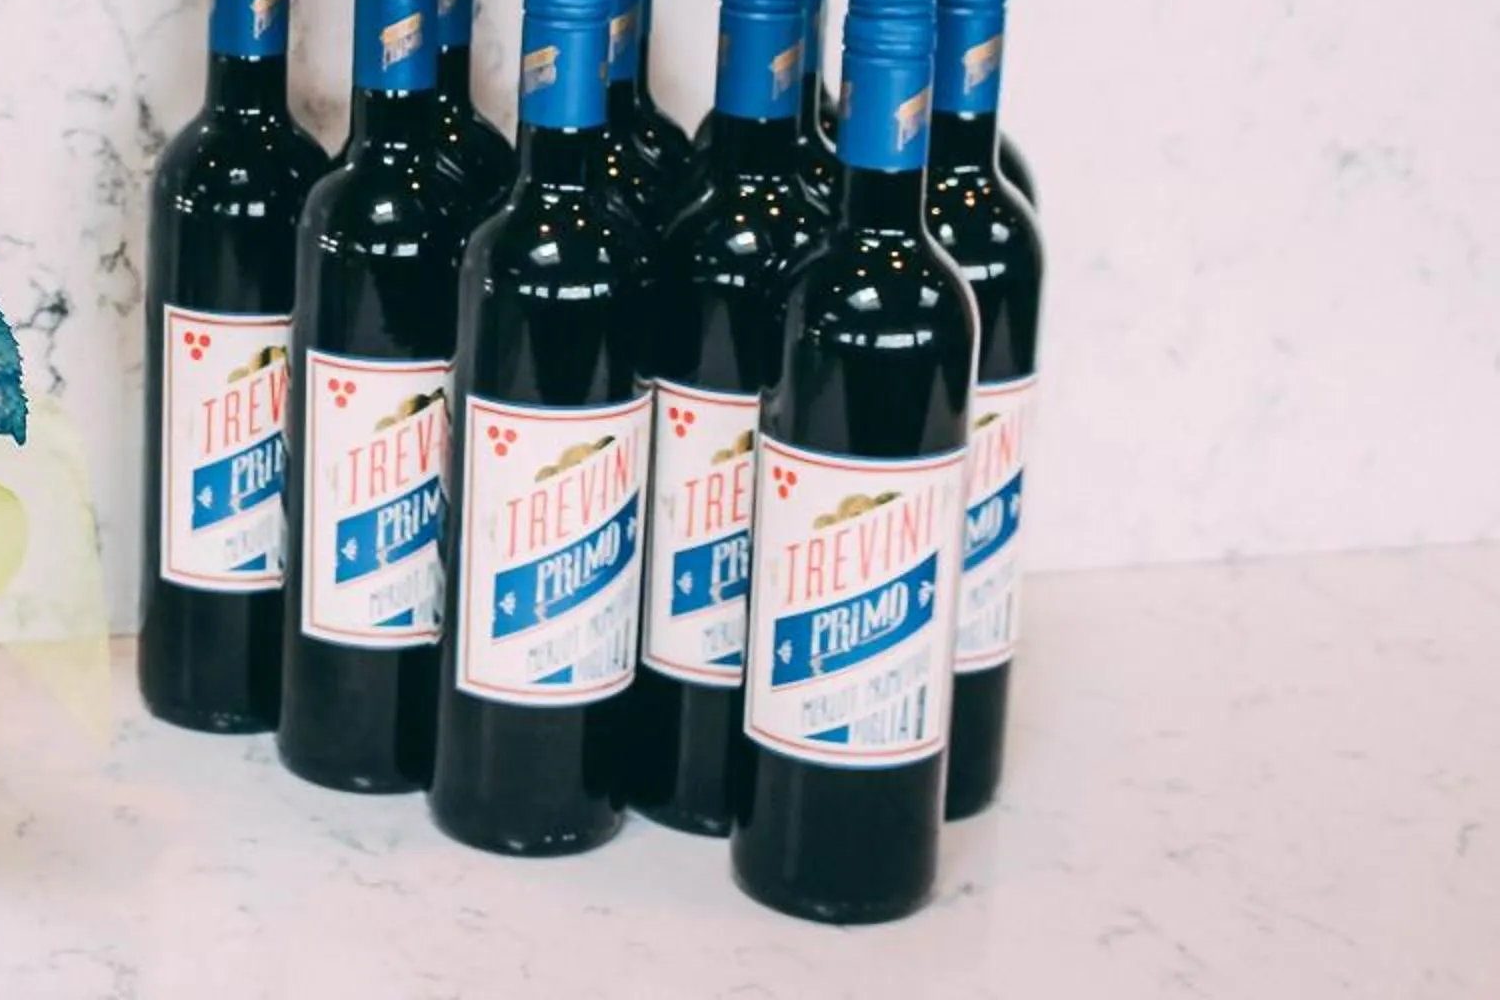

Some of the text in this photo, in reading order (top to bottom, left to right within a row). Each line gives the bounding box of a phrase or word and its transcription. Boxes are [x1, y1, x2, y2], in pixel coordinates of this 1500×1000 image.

[202, 368, 287, 455] TREV
[230, 437, 284, 502] PRI
[348, 412, 435, 505] TREV
[377, 487, 441, 554] PRIM
[785, 482, 934, 605] TREVINI
[535, 523, 621, 608] PRIMO
[810, 580, 908, 664] PRIMO
